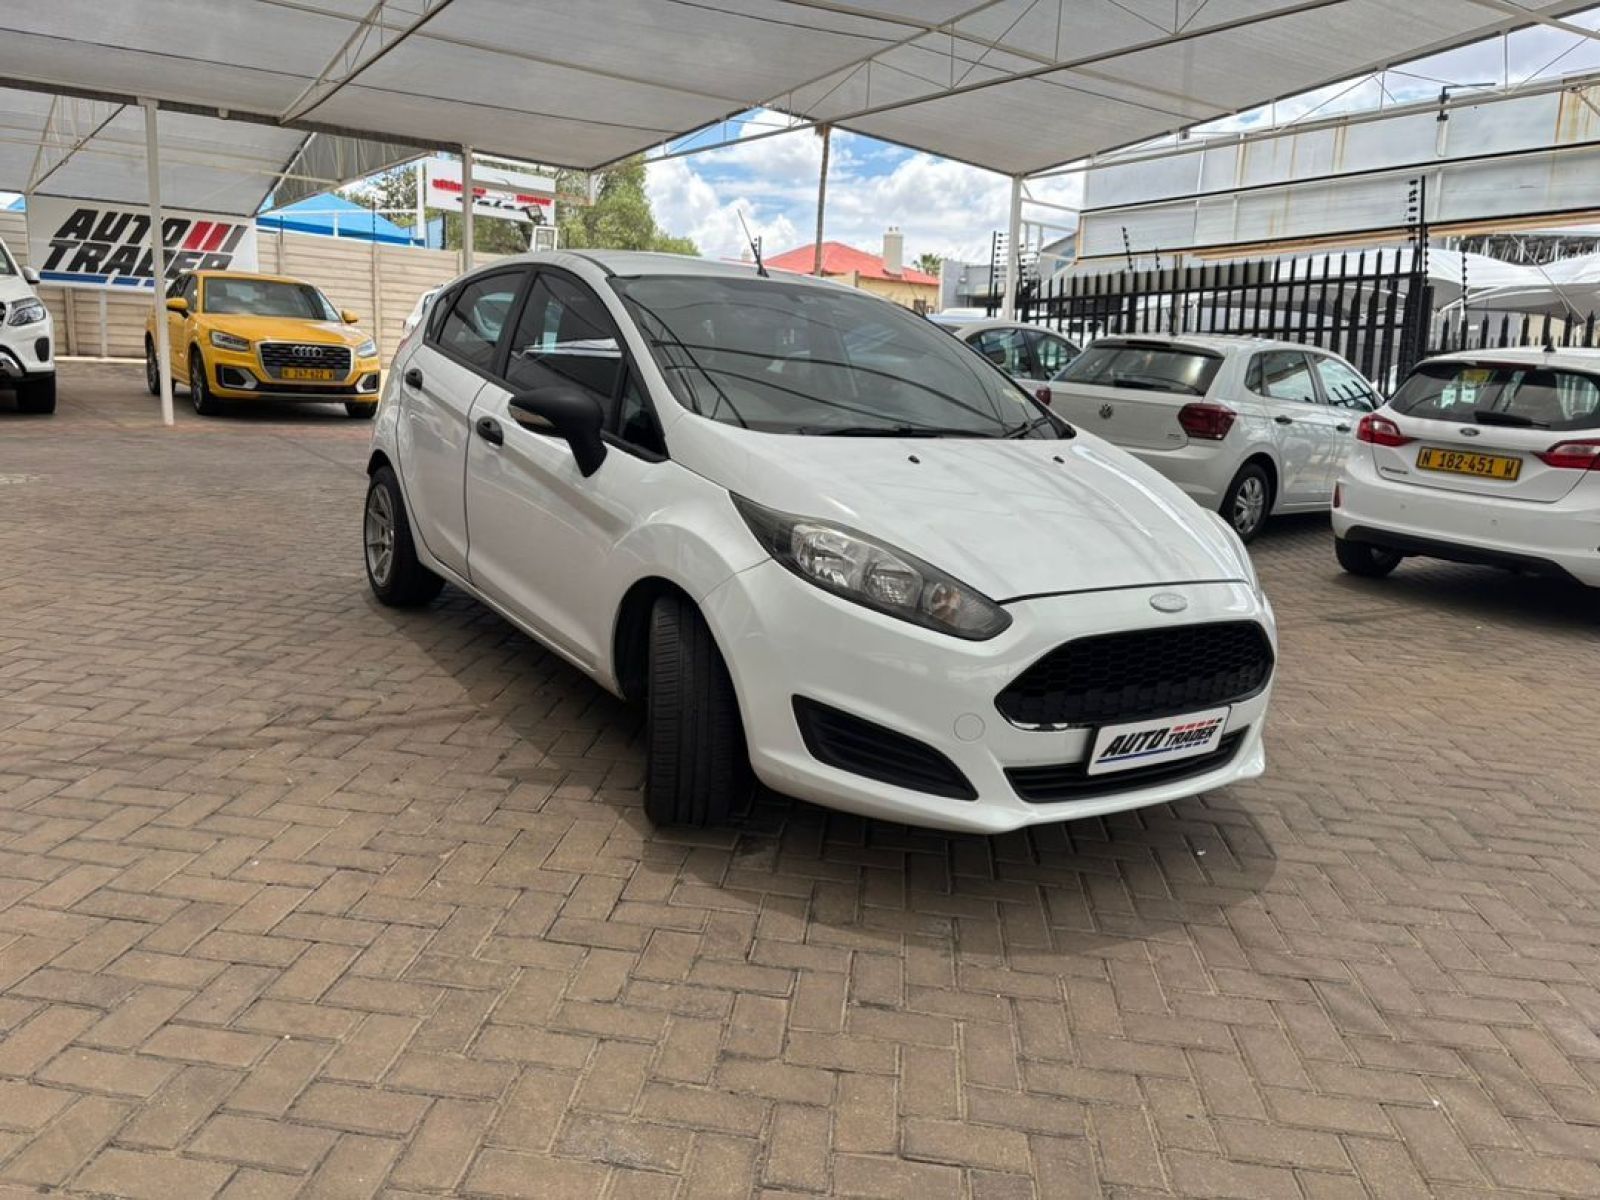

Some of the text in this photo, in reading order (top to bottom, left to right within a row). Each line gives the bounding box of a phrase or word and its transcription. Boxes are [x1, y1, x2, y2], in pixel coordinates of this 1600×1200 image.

[53, 208, 192, 248] AUTO
[1421, 450, 1432, 465] N
[1100, 725, 1219, 757] AUTO TRADER
